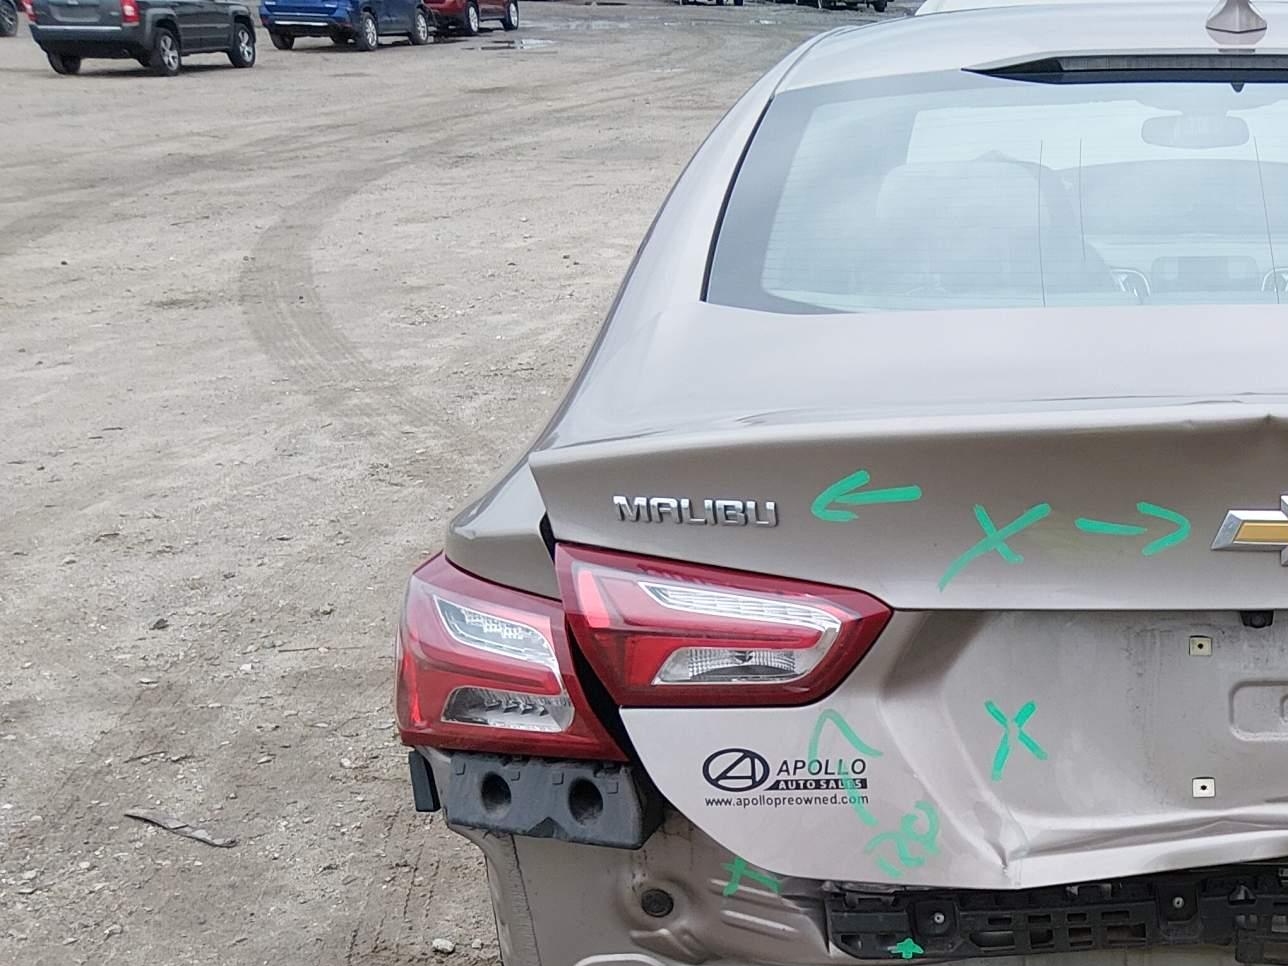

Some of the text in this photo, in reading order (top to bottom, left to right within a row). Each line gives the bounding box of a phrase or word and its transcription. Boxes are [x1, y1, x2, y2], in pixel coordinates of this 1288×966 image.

[613, 494, 779, 528] MALIBU
[776, 758, 867, 776] APOLLO
[778, 779, 863, 790] AUTO SALES
[704, 793, 869, 809] www.apollopreowned.com
